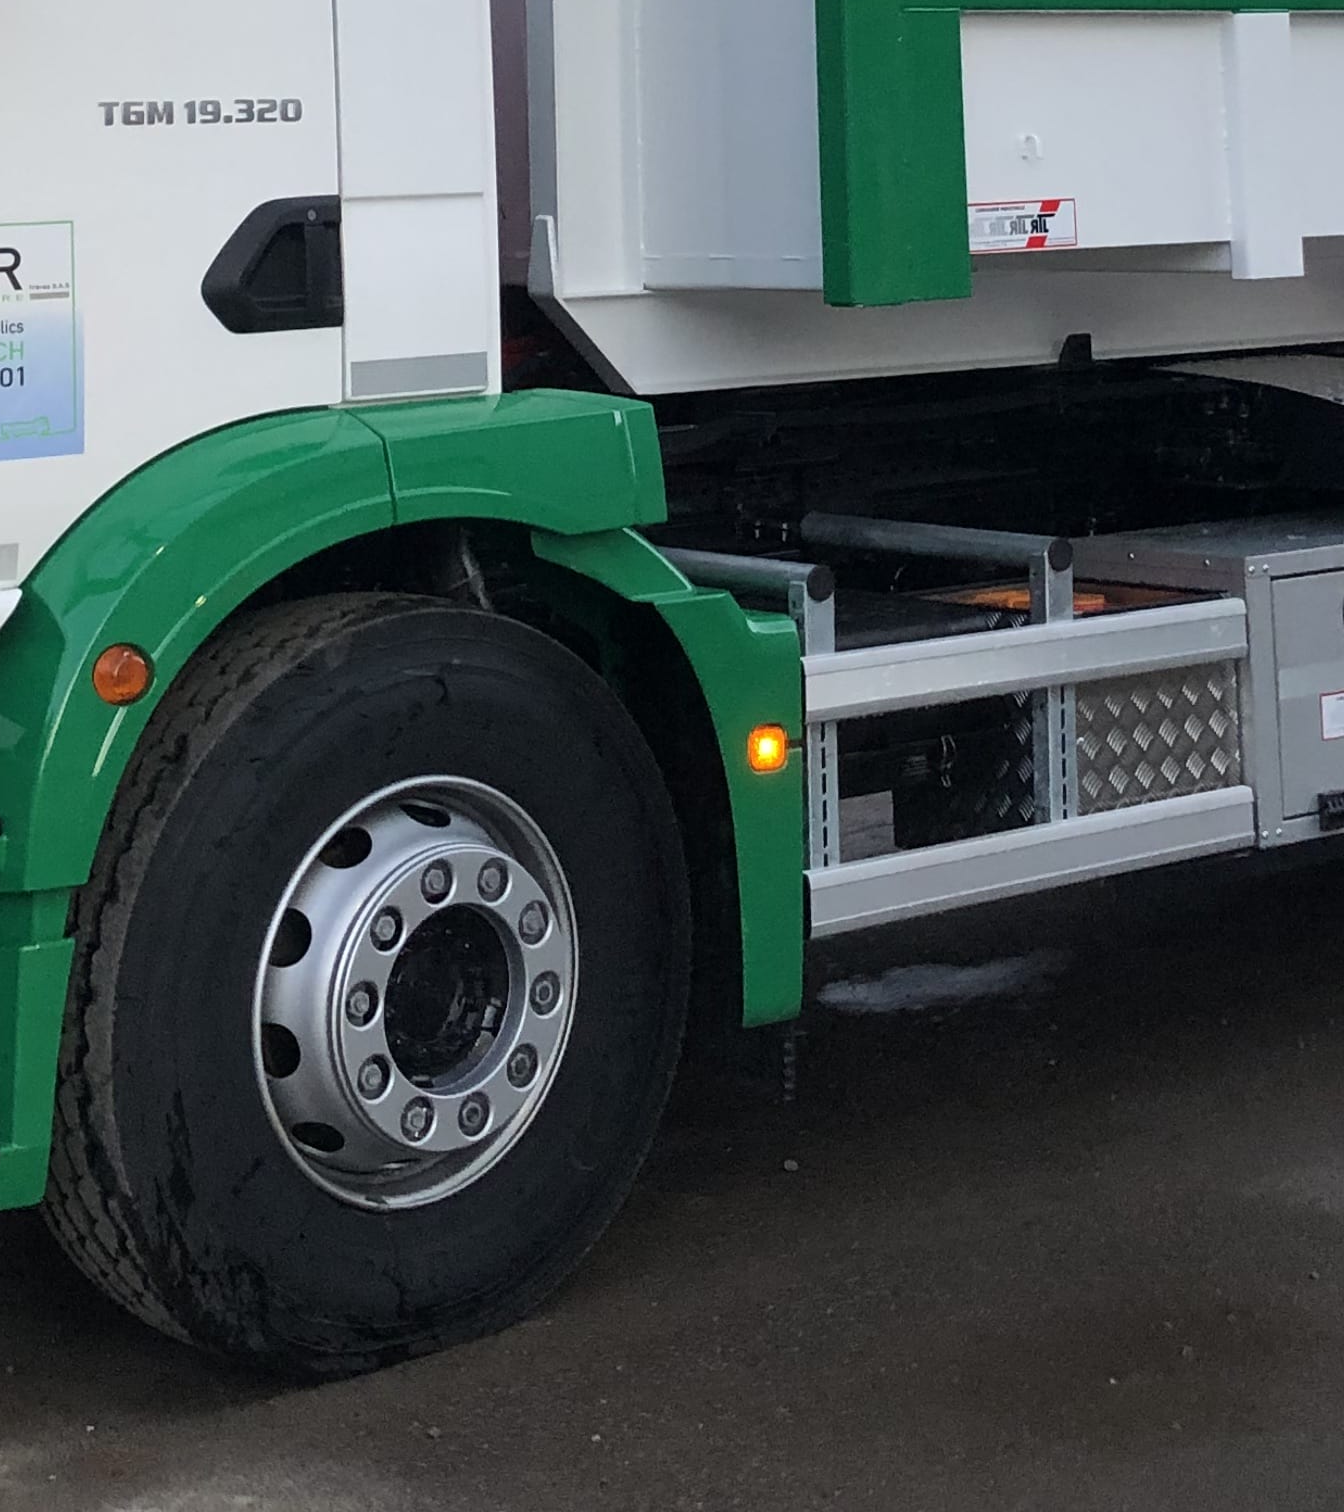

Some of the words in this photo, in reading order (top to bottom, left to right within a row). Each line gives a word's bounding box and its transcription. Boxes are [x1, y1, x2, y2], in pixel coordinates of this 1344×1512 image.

[98, 101, 175, 127] TGM
[183, 98, 303, 125] 19.320
[0, 366, 25, 388] 01
